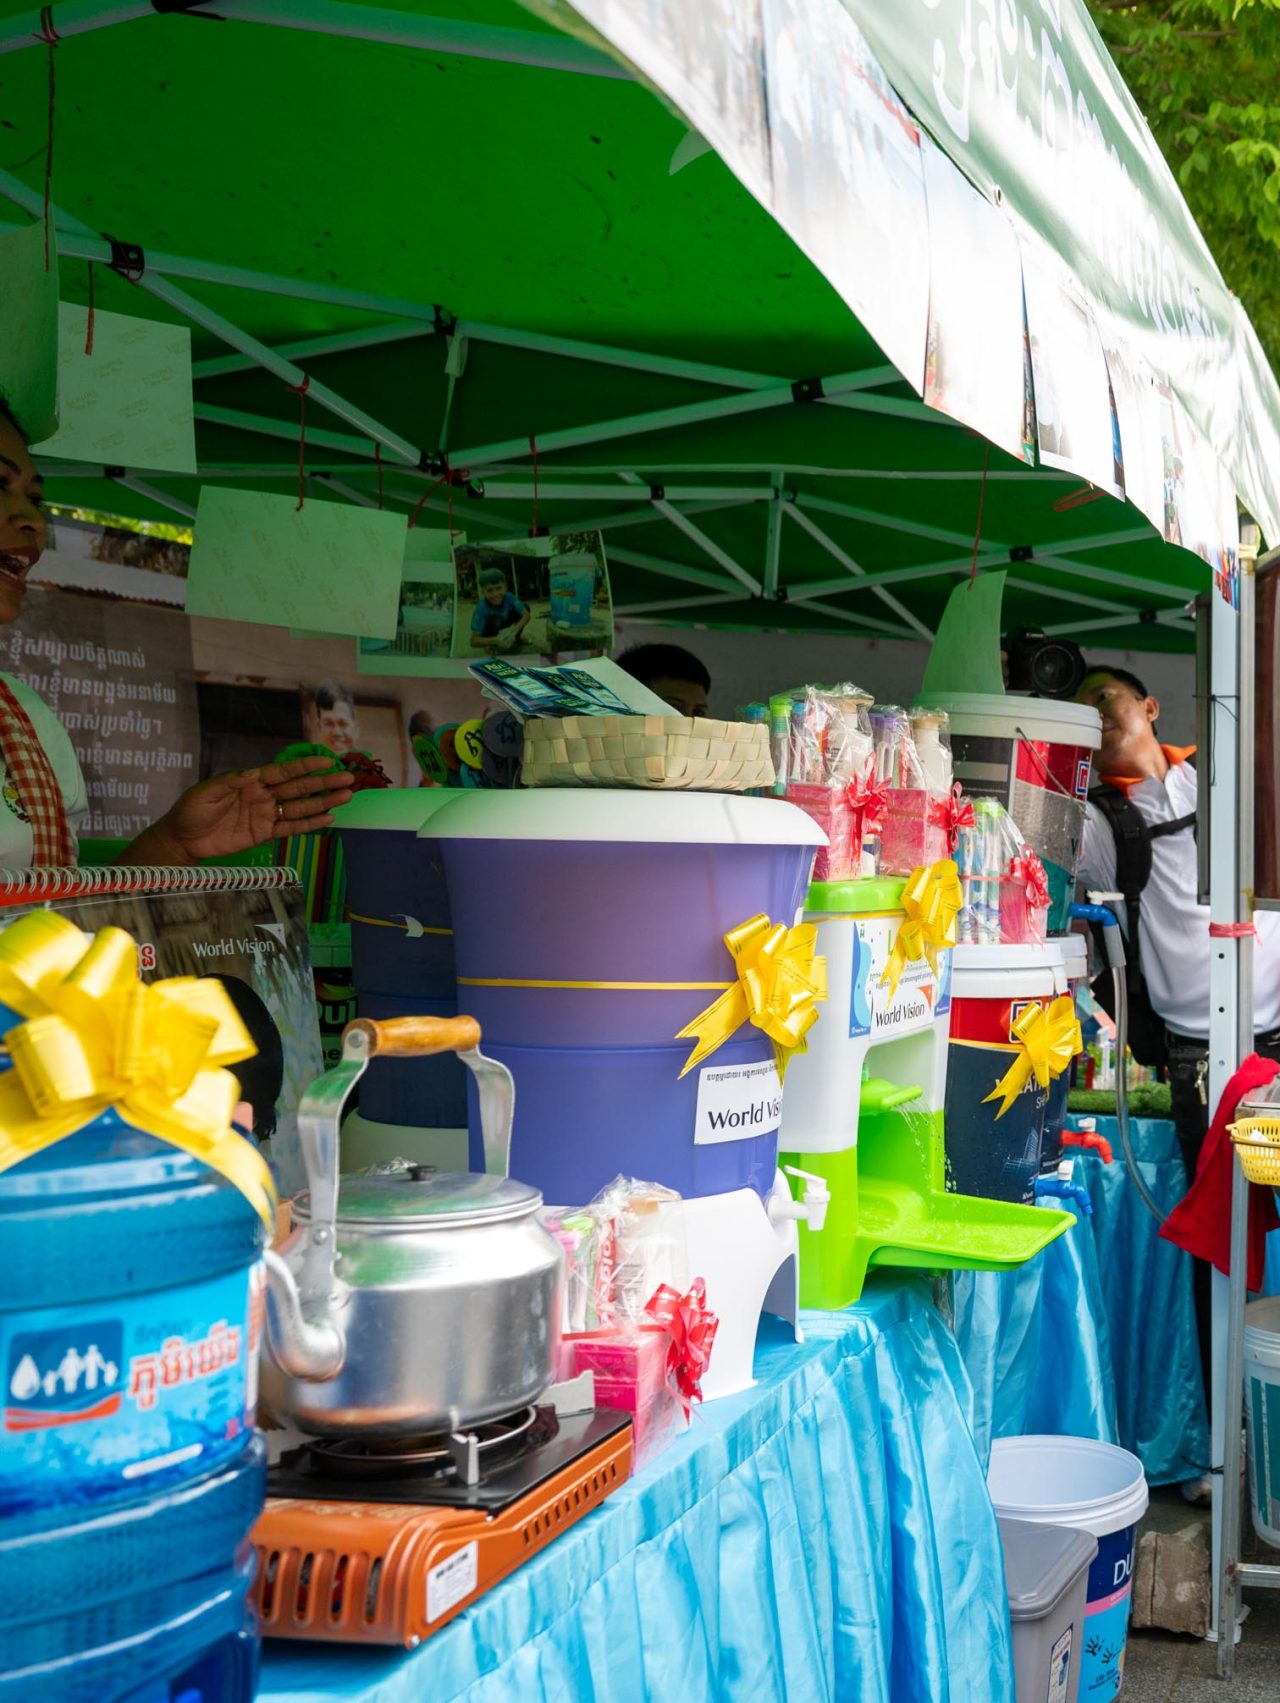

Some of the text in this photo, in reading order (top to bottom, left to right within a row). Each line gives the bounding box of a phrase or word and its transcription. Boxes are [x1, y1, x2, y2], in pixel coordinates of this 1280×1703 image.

[192, 937, 276, 958] World Vision
[875, 1004, 901, 1028] World
[903, 1001, 925, 1020] Vision
[708, 1098, 780, 1130] World Vis
